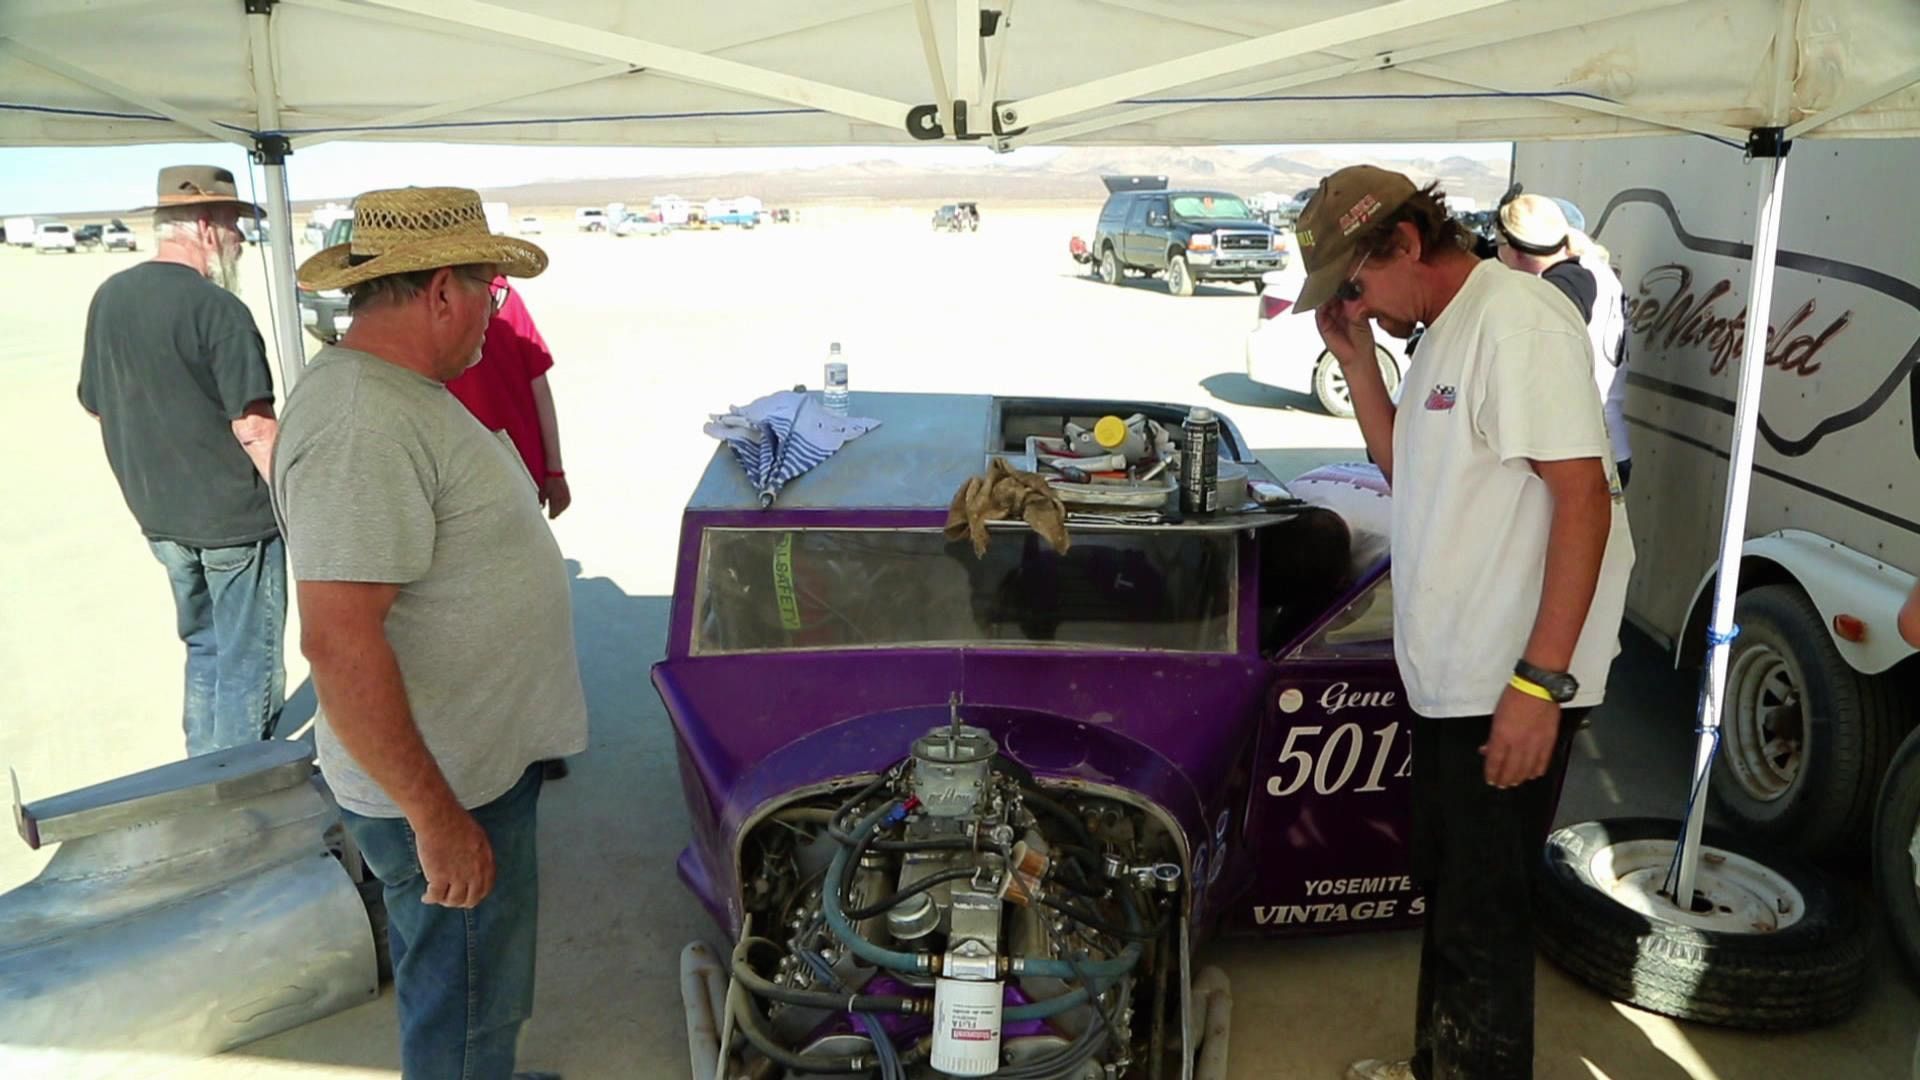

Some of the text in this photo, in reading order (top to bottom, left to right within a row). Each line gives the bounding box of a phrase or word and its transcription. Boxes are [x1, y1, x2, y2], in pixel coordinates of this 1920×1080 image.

[776, 562, 799, 626] SAFETY
[1316, 681, 1395, 714] Gene
[1304, 876, 1412, 896] YOSEMITE
[1253, 900, 1398, 924] VINTAGE
